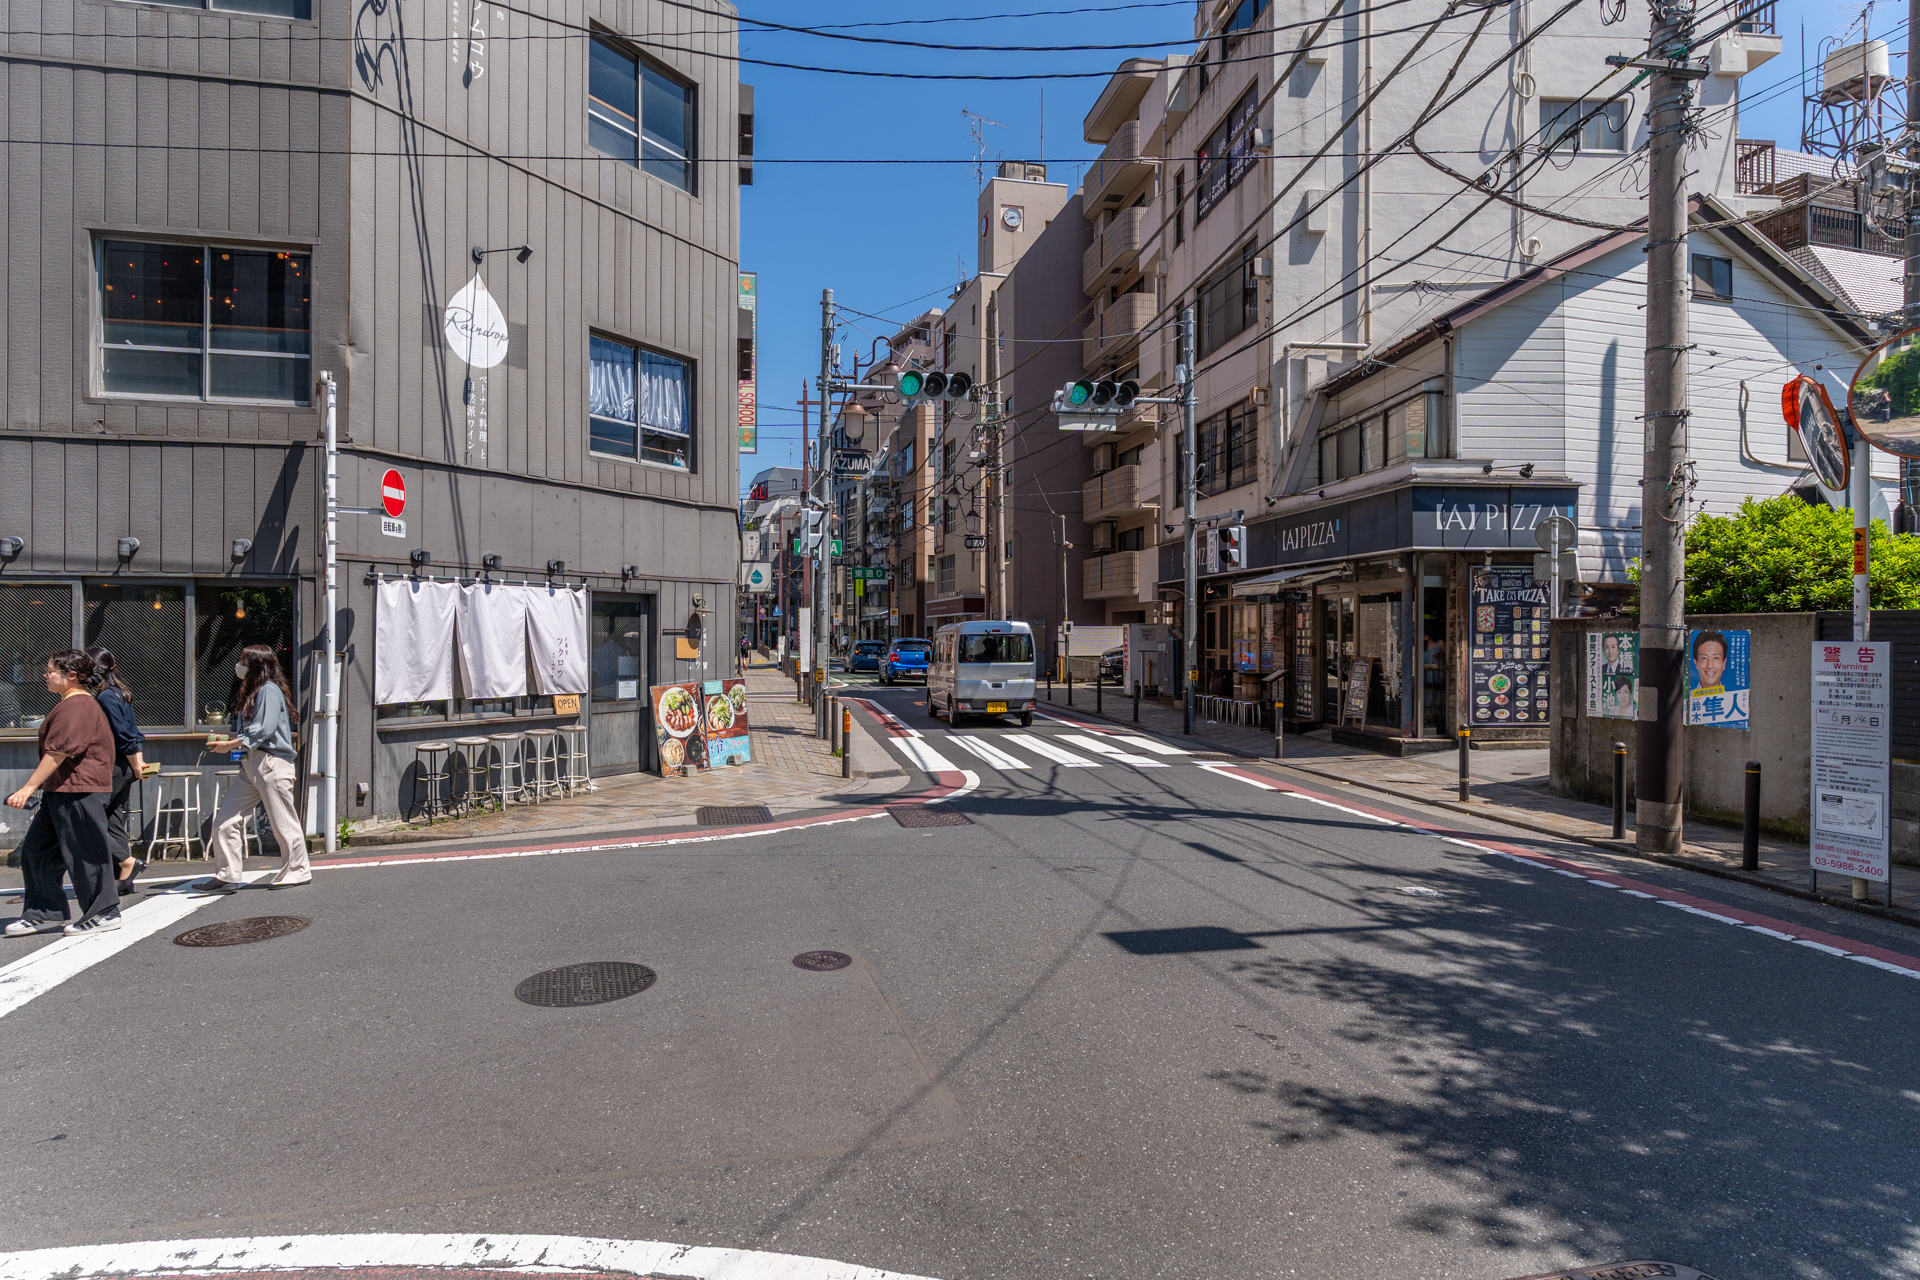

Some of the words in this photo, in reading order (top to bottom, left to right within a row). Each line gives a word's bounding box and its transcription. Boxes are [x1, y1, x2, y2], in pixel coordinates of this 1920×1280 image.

[446, 306, 510, 347] Raindrop
[466, 380, 476, 449] 自然派ワイン
[739, 392, 754, 426] SCHOOL
[833, 457, 871, 471] AZUMA
[1300, 520, 1336, 549] PIZZA
[854, 569, 883, 578] 東通り
[1477, 587, 1505, 604] TAKE
[1517, 587, 1547, 604] PIZZA
[1618, 633, 1633, 669] 本橋
[1823, 646, 1876, 663] 警告
[1589, 634, 1597, 709] 都民ファーストの会
[1833, 662, 1869, 671] Warning
[557, 698, 577, 709] OPEN
[1602, 676, 1617, 710] 小池
[1691, 701, 1702, 723] 鈴木
[1702, 693, 1747, 721] 隼人
[1840, 715, 1851, 725] 月
[1869, 716, 1879, 727] 日
[1814, 856, 1884, 877] 03-5986-2400
